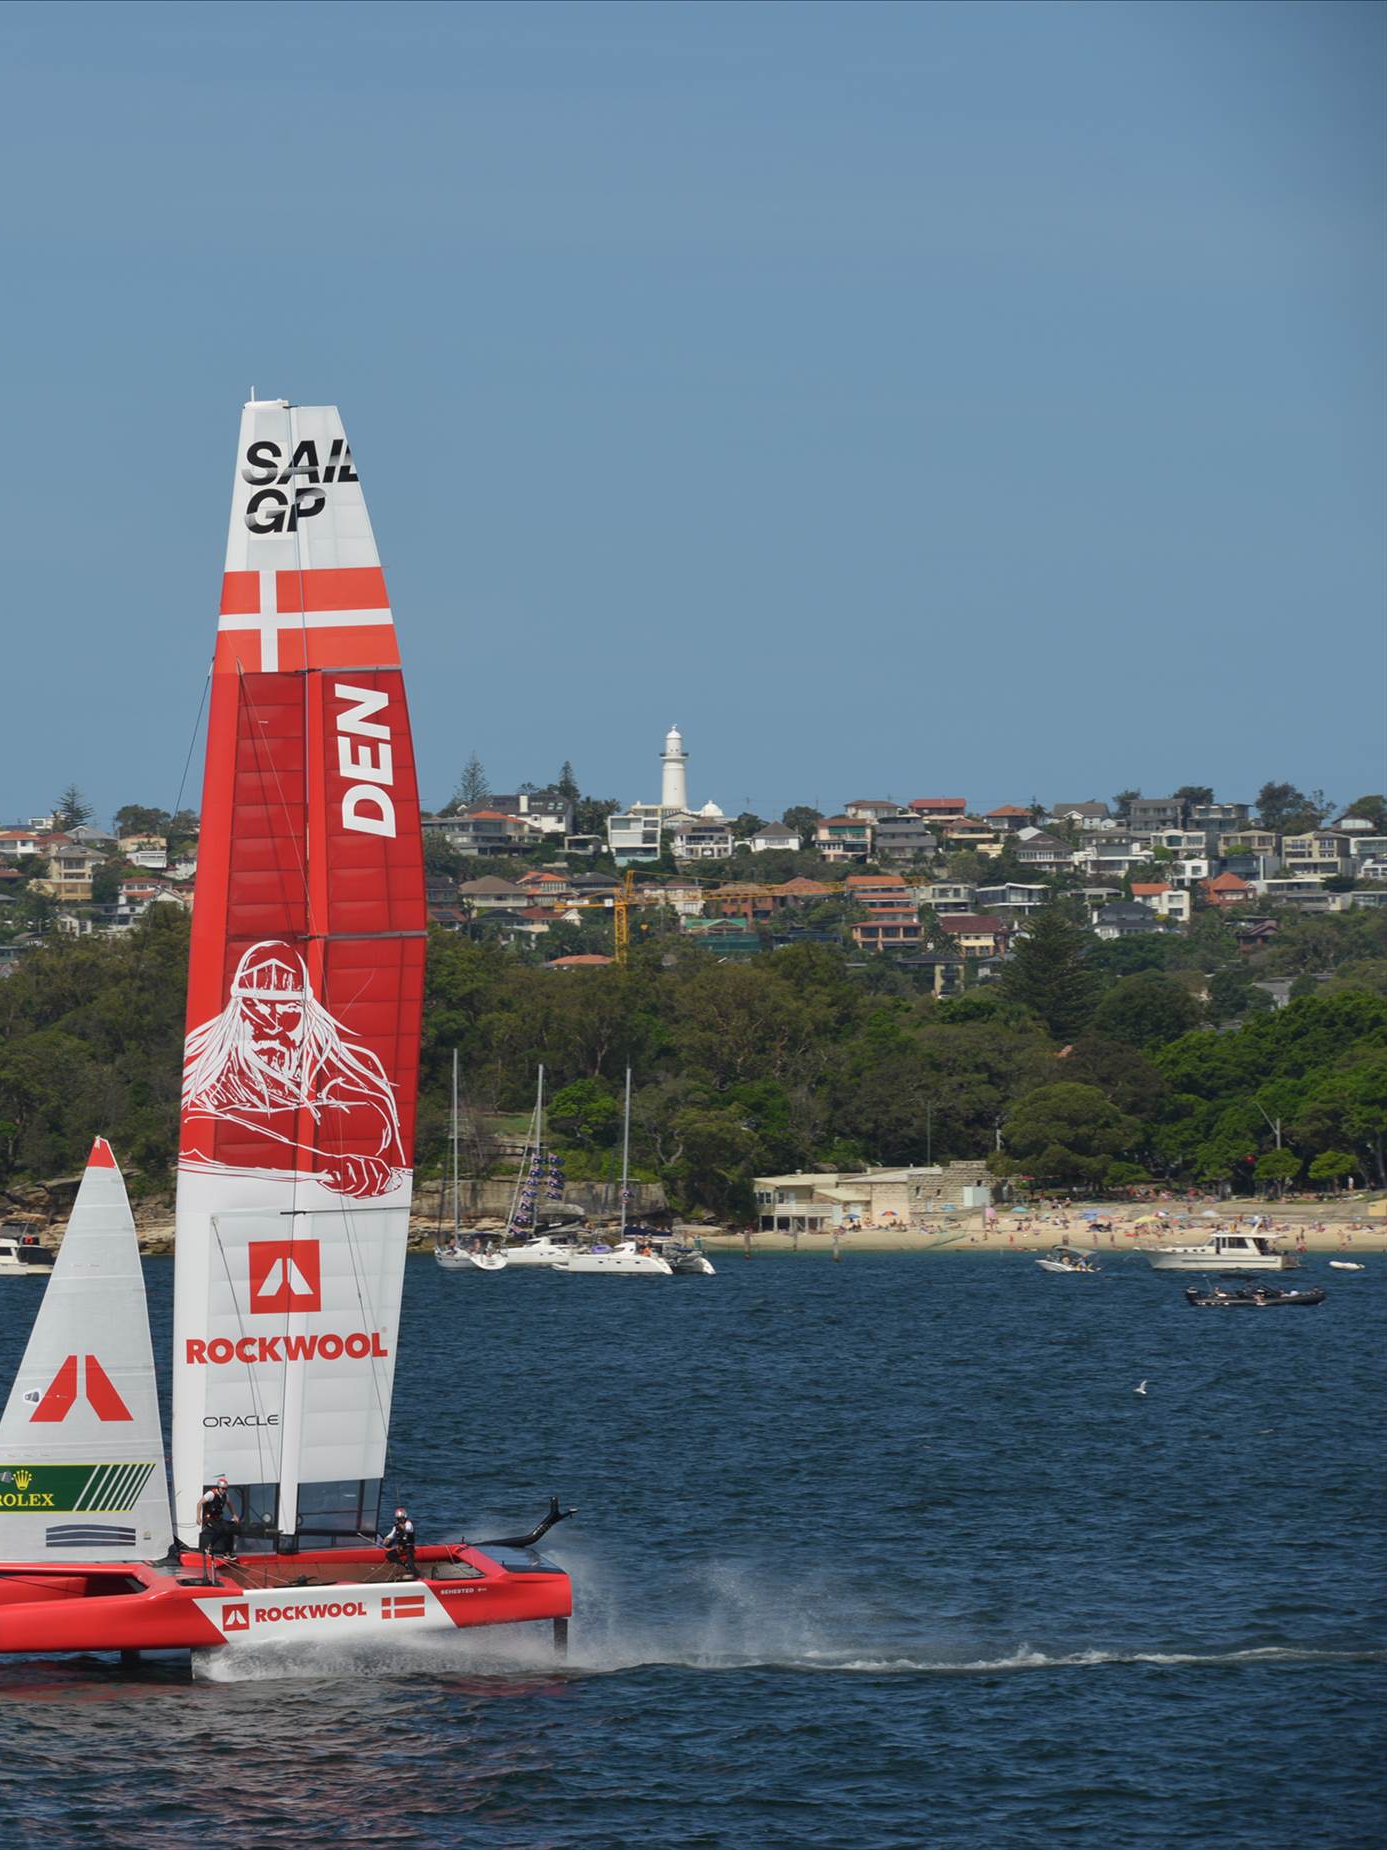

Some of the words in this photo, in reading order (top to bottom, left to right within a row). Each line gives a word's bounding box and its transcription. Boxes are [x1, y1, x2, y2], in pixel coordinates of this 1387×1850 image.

[244, 487, 327, 534] GP
[335, 683, 396, 838] DEN
[186, 1332, 388, 1364] ROCKWOOL
[203, 1414, 280, 1428] ORACLE
[255, 1602, 367, 1622] ROCKWOOL
